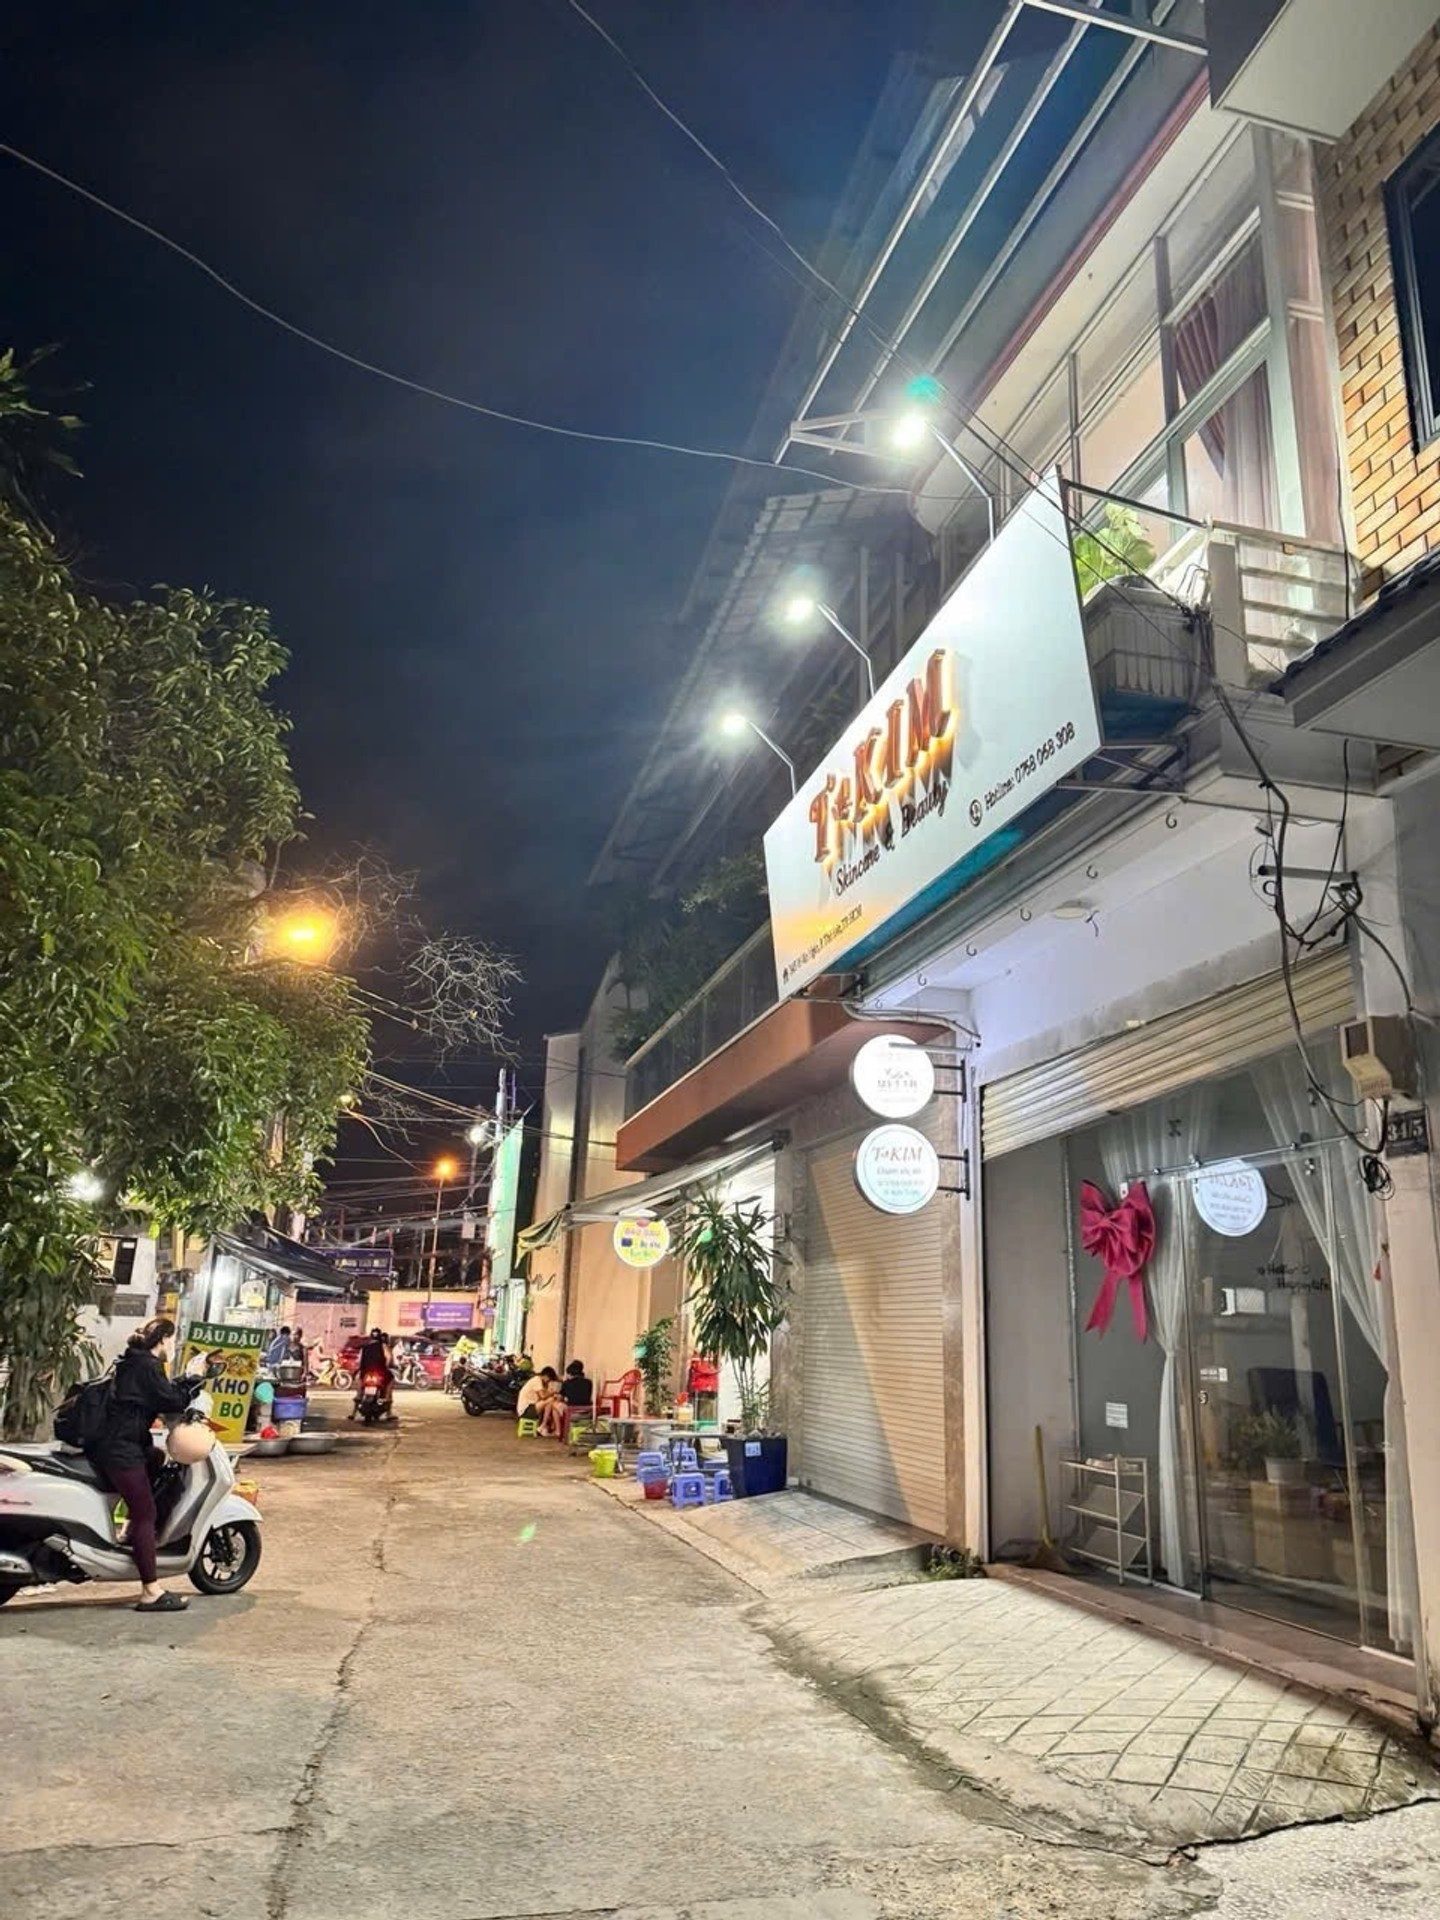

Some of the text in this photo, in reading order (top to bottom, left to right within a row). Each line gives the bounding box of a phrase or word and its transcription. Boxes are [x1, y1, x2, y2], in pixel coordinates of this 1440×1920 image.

[1055, 721, 1075, 750] 308
[901, 780, 949, 838] Beauty
[212, 1377, 250, 1395] KHO
